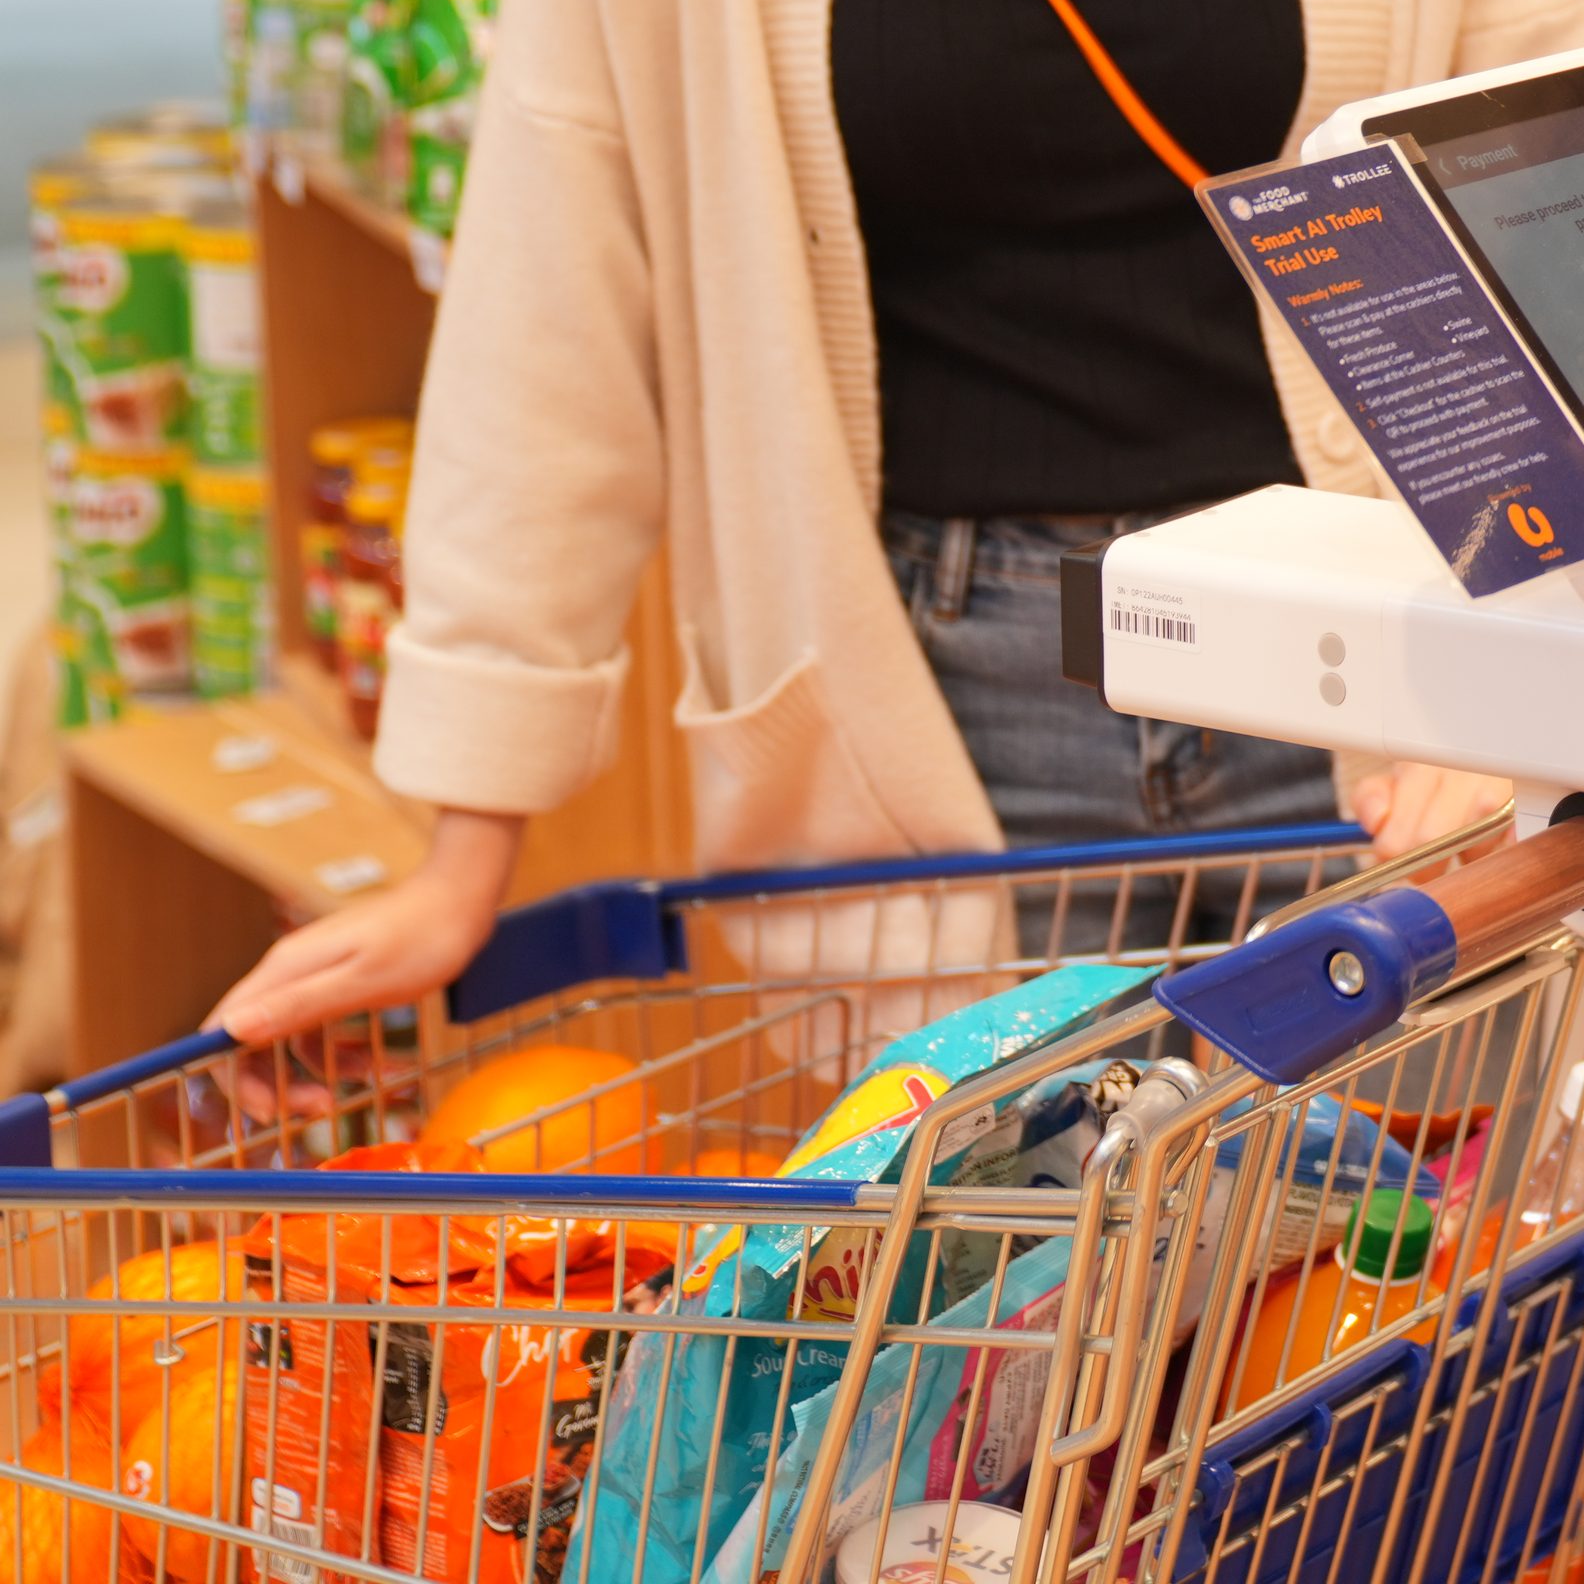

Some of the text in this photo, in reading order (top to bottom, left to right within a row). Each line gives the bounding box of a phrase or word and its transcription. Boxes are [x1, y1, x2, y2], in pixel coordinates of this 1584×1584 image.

[1456, 144, 1517, 169] Payment
[1342, 164, 1391, 184] TROLLEE
[1249, 191, 1307, 213] MERCHANT
[1259, 186, 1289, 201] FOOD
[1494, 210, 1536, 229] Please
[1535, 194, 1582, 221] proceed
[1250, 206, 1382, 252] Smart AI Trolley
[1264, 246, 1338, 275] Trial Use
